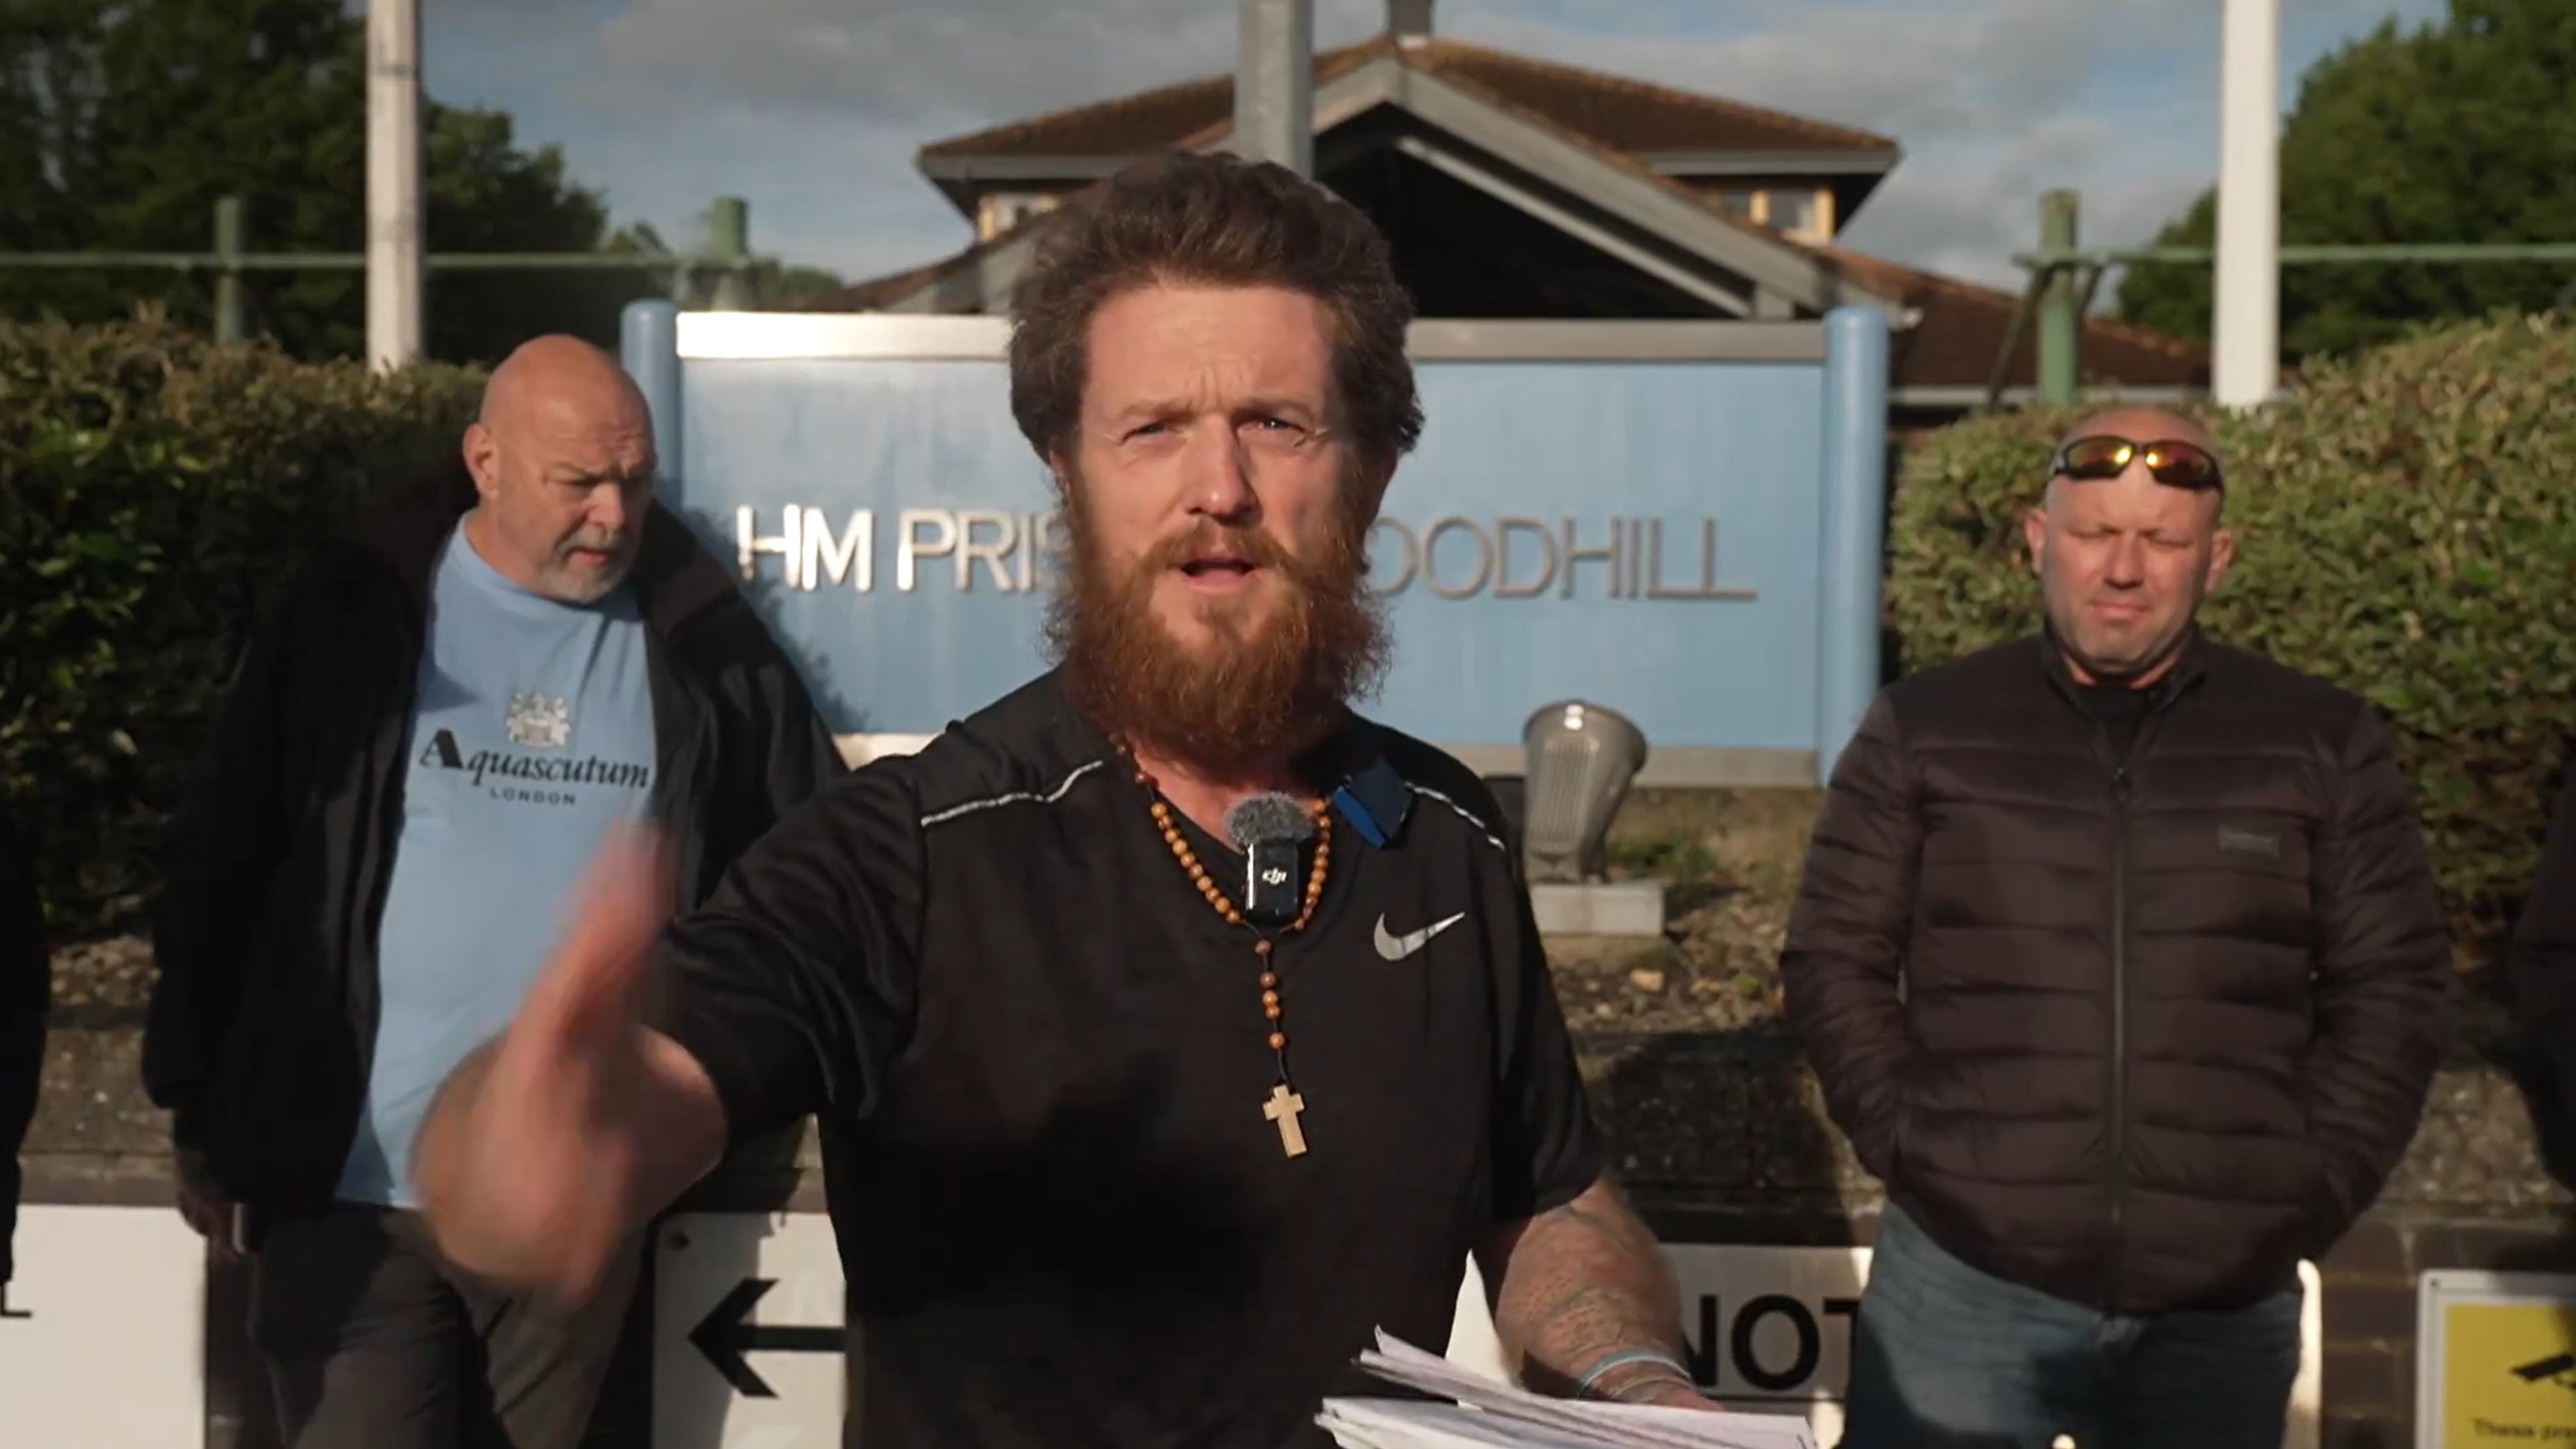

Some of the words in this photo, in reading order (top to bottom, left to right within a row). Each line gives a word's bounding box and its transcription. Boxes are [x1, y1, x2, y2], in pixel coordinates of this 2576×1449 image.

[737, 504, 873, 591] HM
[896, 508, 1068, 592] PRIS
[1365, 516, 1758, 600] OODHILL
[419, 727, 649, 790] Aquascutum
[490, 788, 576, 806] LONDON
